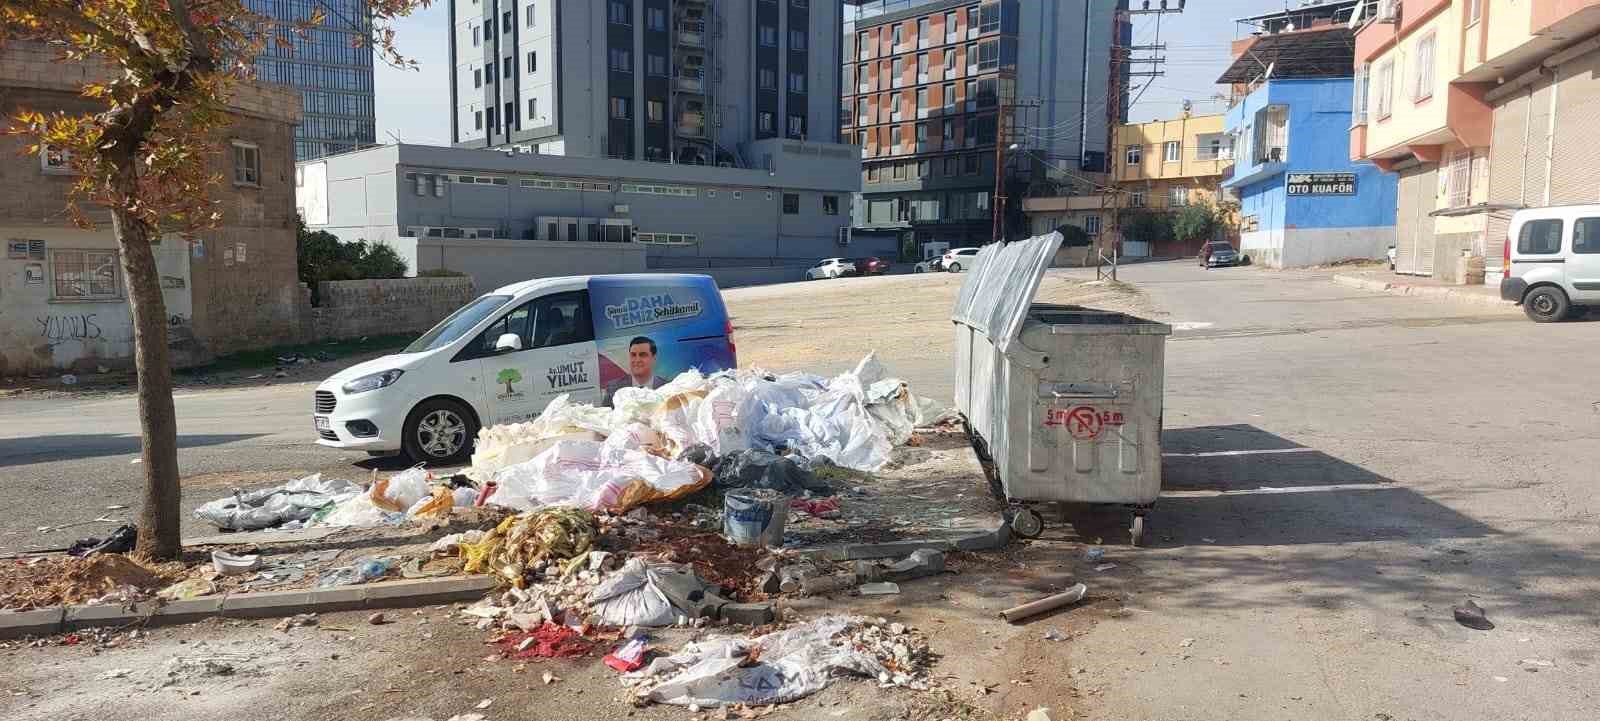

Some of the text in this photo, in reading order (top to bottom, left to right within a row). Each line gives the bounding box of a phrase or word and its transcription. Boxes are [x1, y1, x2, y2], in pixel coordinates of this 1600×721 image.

[1288, 182, 1353, 194] OTO KUAFÖR
[627, 293, 674, 310] DAHA
[36, 313, 102, 339] YUNUS
[546, 373, 588, 389] YILMAZ
